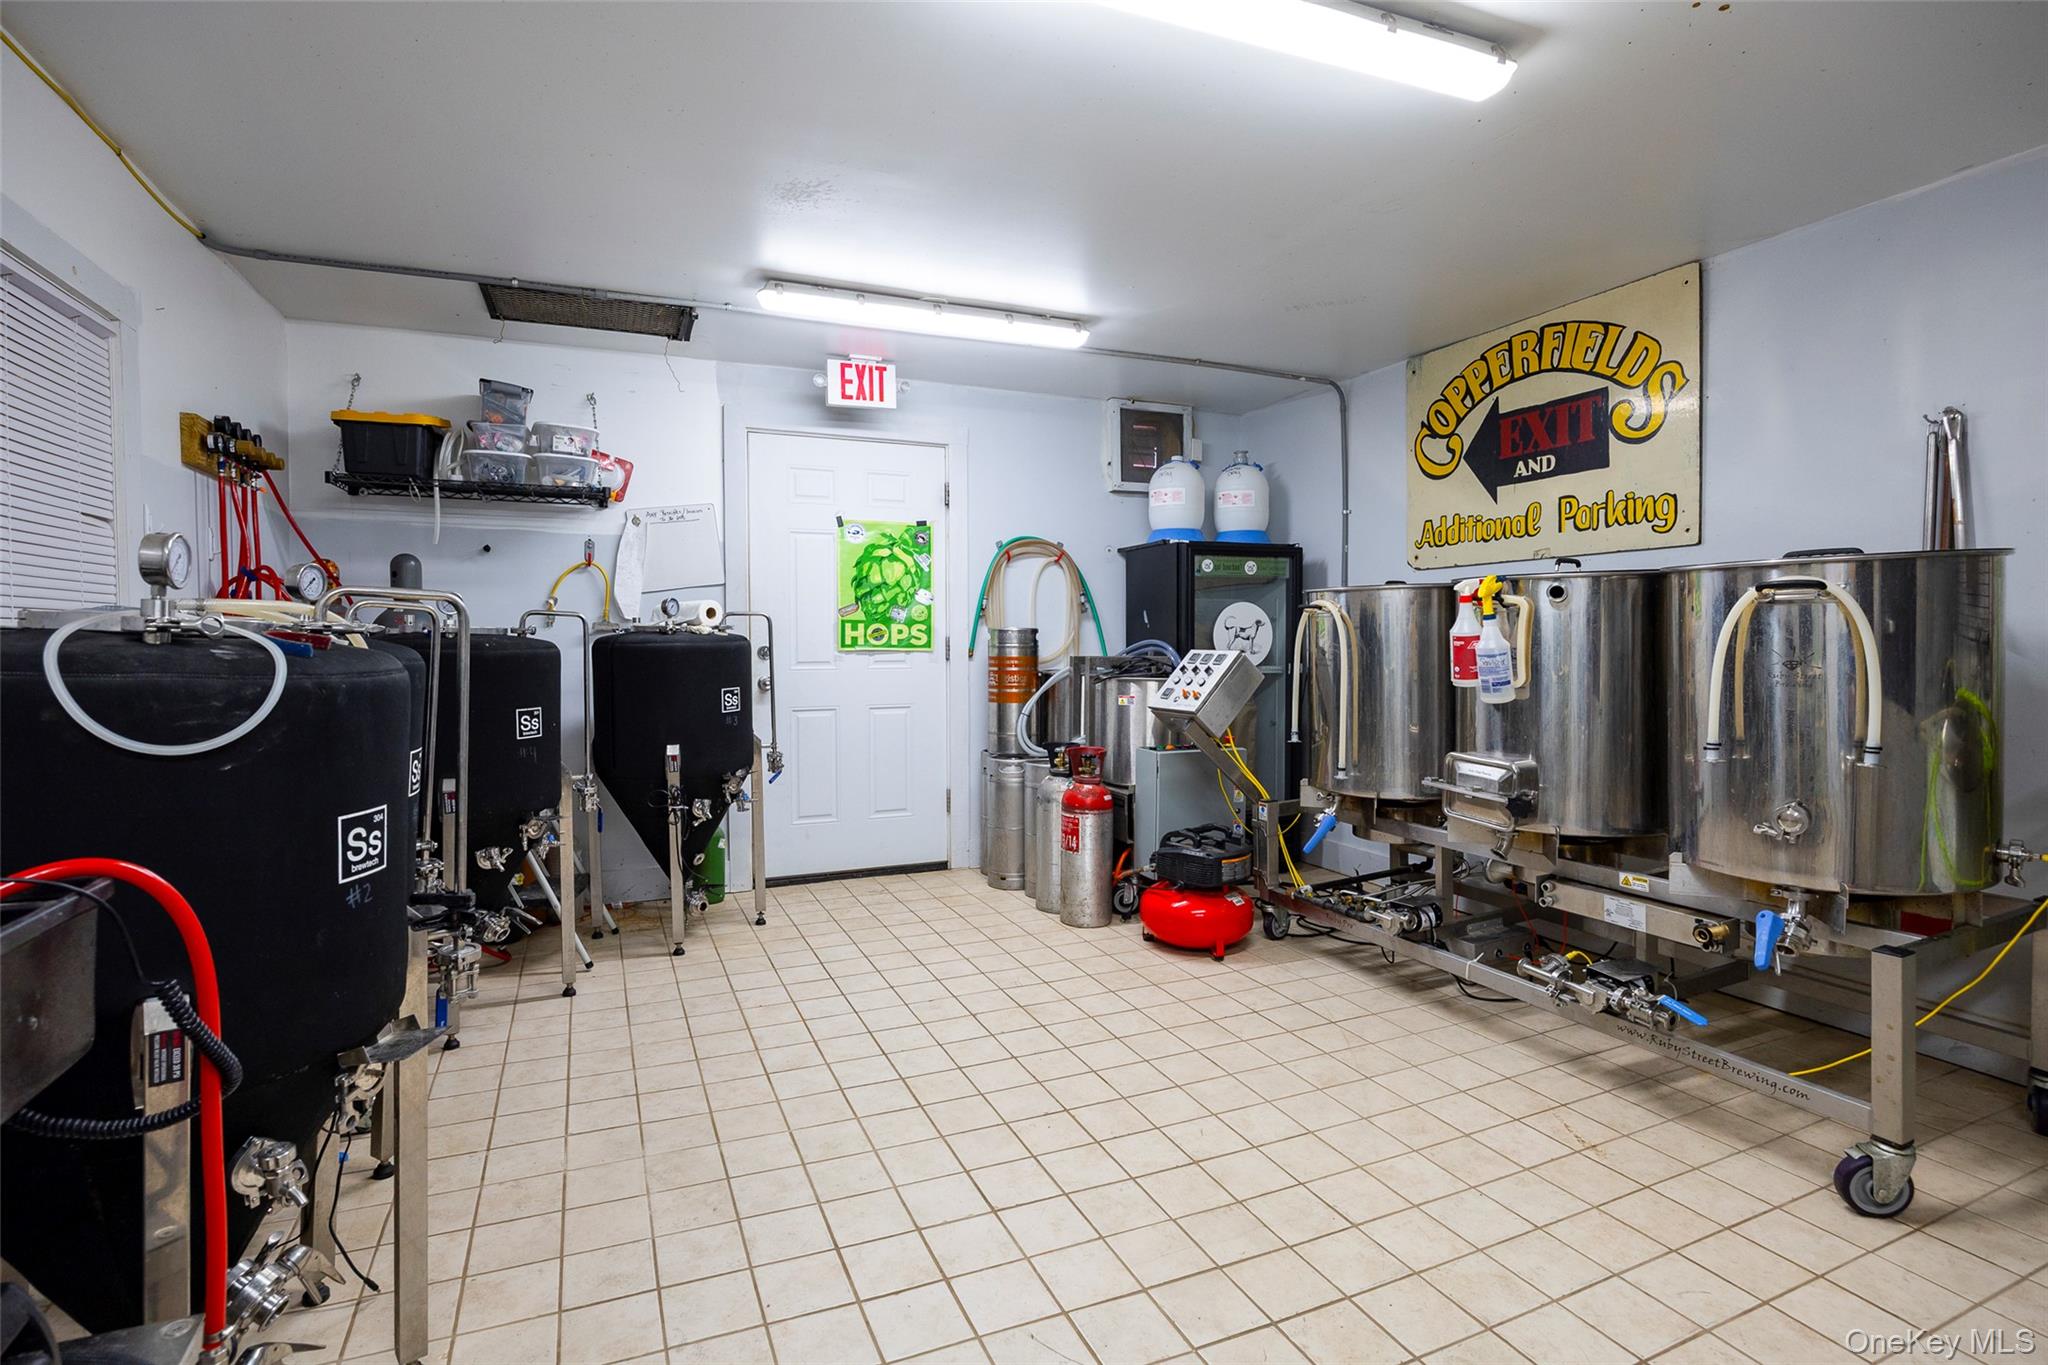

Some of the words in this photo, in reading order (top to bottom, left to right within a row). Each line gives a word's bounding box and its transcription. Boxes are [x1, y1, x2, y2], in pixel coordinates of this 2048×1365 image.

[840, 362, 887, 402] EXIT
[1414, 320, 1690, 480] COPPERFIELDS
[1499, 394, 1605, 460] EXIT
[1513, 454, 1556, 478] AND
[1414, 501, 1543, 549] Additional
[1558, 489, 1678, 534] Parking
[844, 622, 929, 646] HOPS
[725, 693, 738, 706] Ss
[520, 715, 539, 731] Ss
[346, 827, 382, 862] Ss
[351, 857, 380, 873] brewtech
[345, 882, 374, 909] #2
